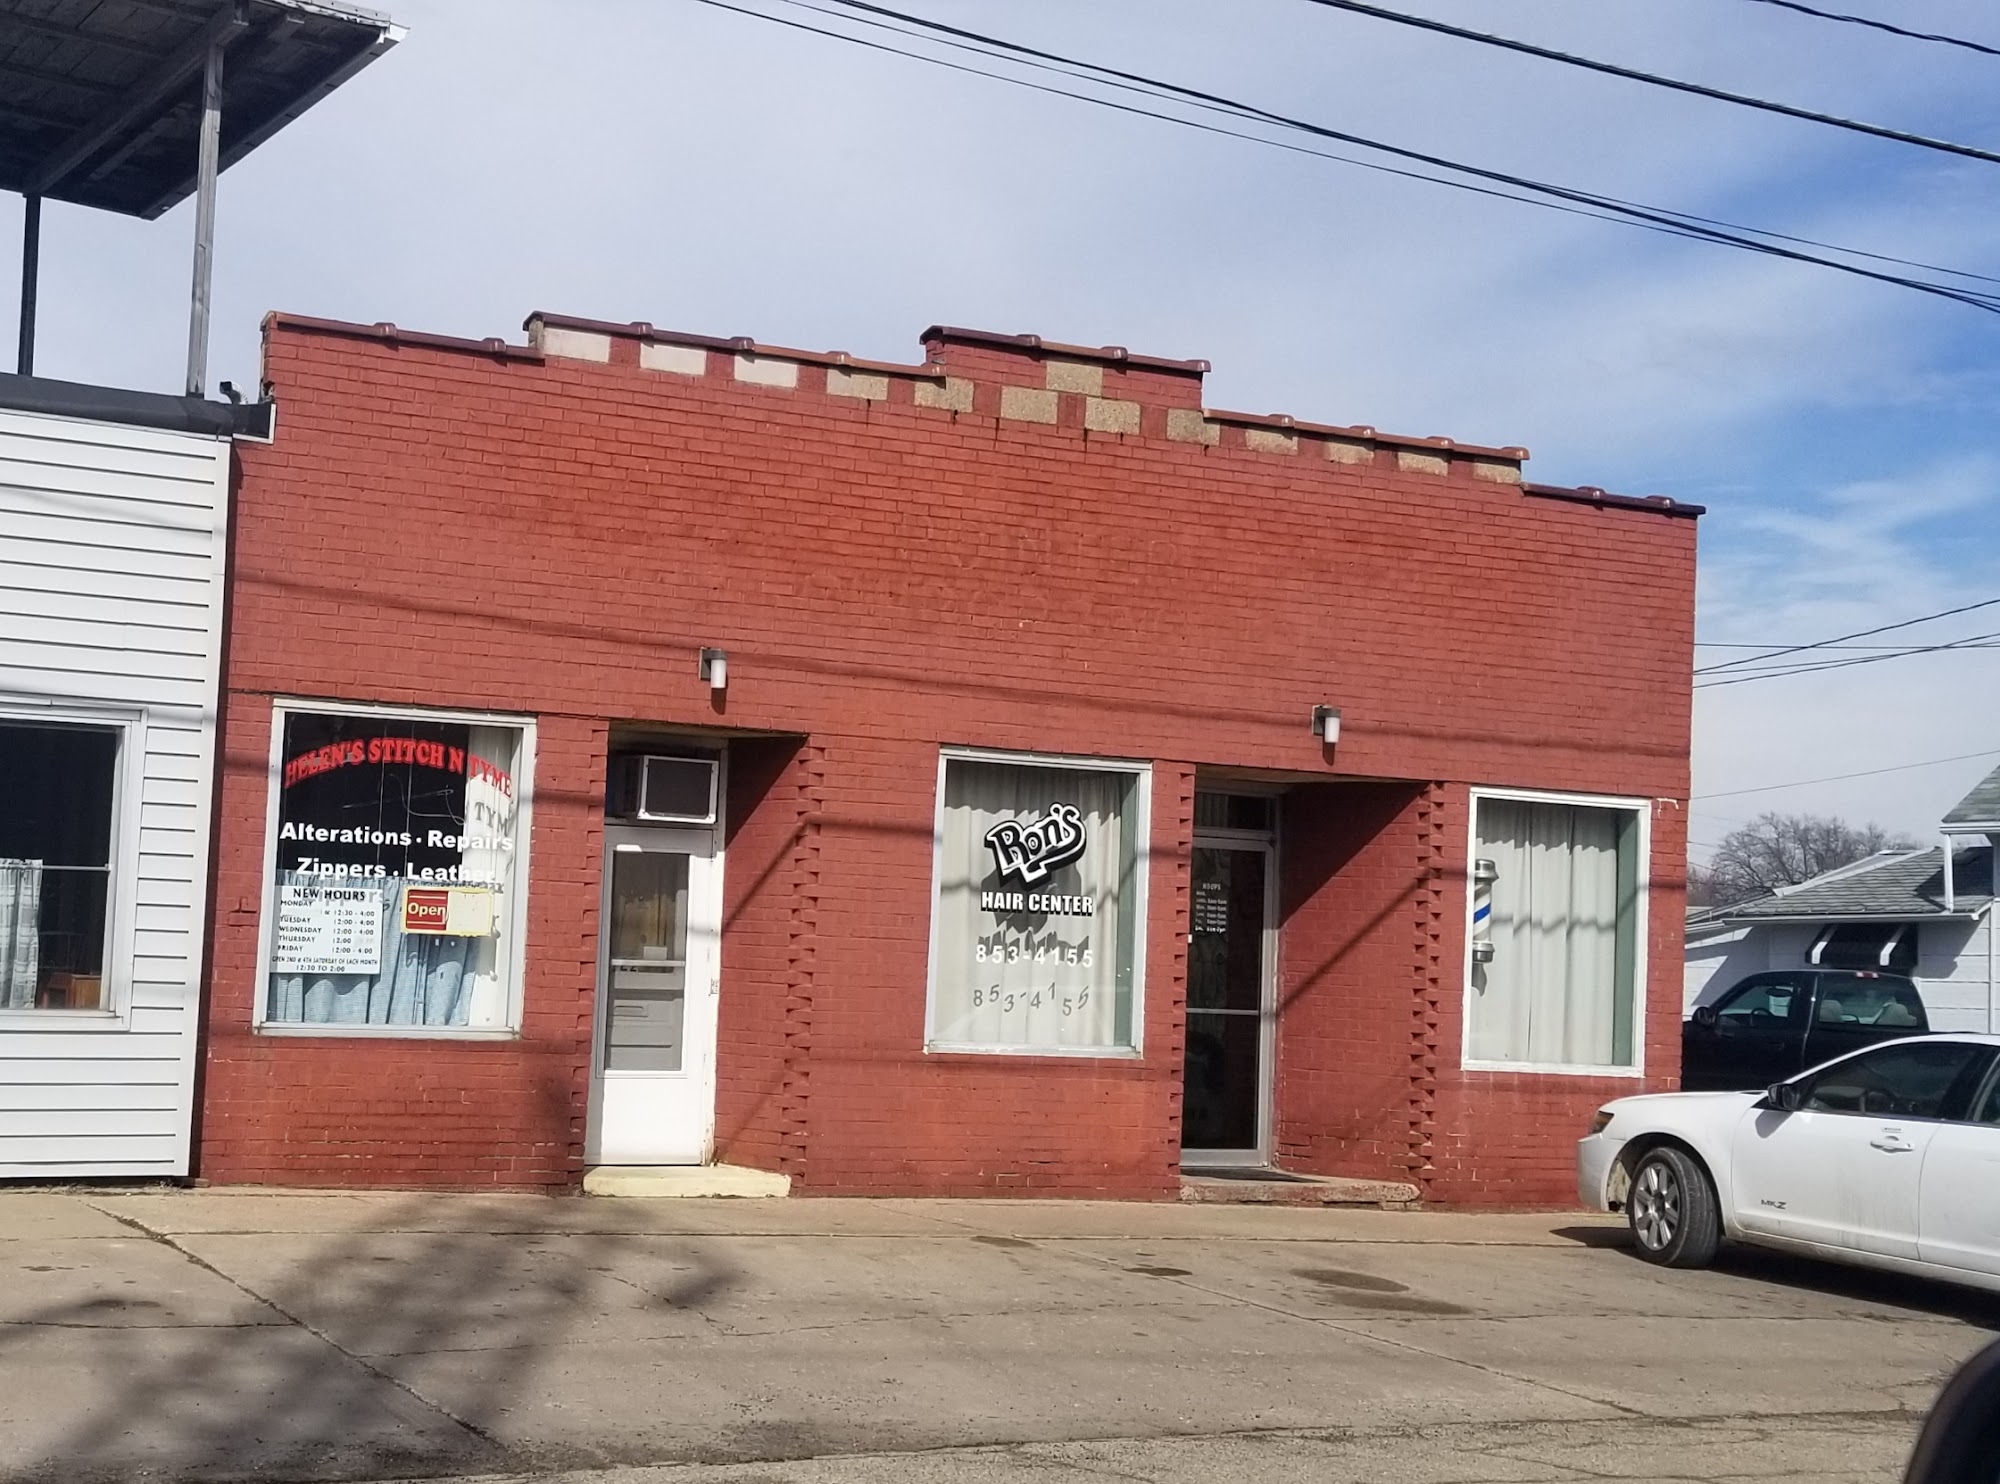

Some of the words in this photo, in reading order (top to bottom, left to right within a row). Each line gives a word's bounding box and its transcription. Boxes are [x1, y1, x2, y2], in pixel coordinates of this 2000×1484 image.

[283, 738, 365, 789] HELEN'S
[367, 737, 445, 767] STITCH
[448, 745, 466, 774] N
[467, 753, 513, 799] TYME
[279, 822, 412, 846] Alterations
[427, 830, 514, 853] Repairs
[984, 801, 1087, 889] Ron's
[296, 857, 387, 881] Zippers
[407, 862, 495, 883] Leather
[293, 888, 319, 899] NEW
[324, 890, 365, 901] HOURS
[981, 891, 1023, 914] HAIR
[1028, 893, 1094, 917] CENTER
[407, 902, 446, 917] Open
[278, 926, 322, 934] WEDNESDAY
[279, 935, 316, 943] THURSDAY
[975, 944, 1093, 969] 853-4155
[1761, 1199, 1787, 1210] MKZ
